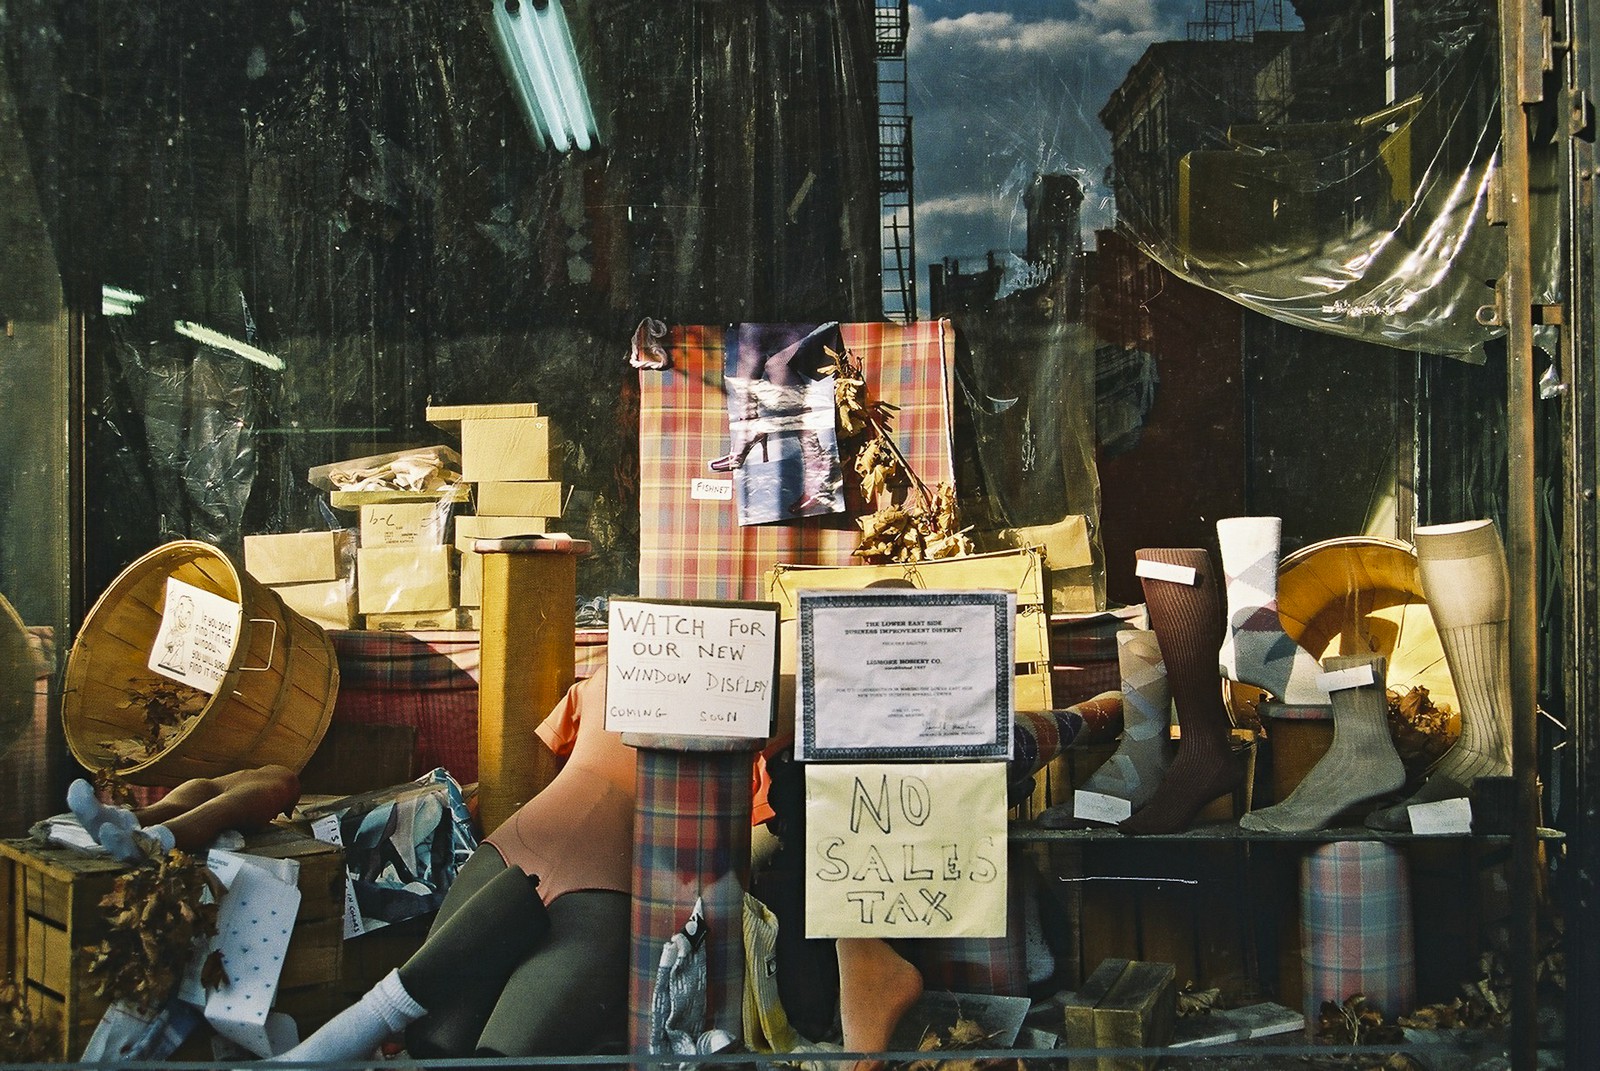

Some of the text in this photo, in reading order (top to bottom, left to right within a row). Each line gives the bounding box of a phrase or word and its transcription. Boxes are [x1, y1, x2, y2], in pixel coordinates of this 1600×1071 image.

[696, 481, 730, 494] FISHNET
[618, 608, 766, 639] WATCH FOR
[879, 627, 931, 635] IMPROVEMENT
[632, 642, 746, 660] OUR NEW
[616, 665, 768, 700] WINDOW DISPLAY
[611, 706, 667, 718] COMING
[850, 774, 931, 834] NO
[816, 836, 997, 884] SALES
[847, 888, 953, 925] TAX
